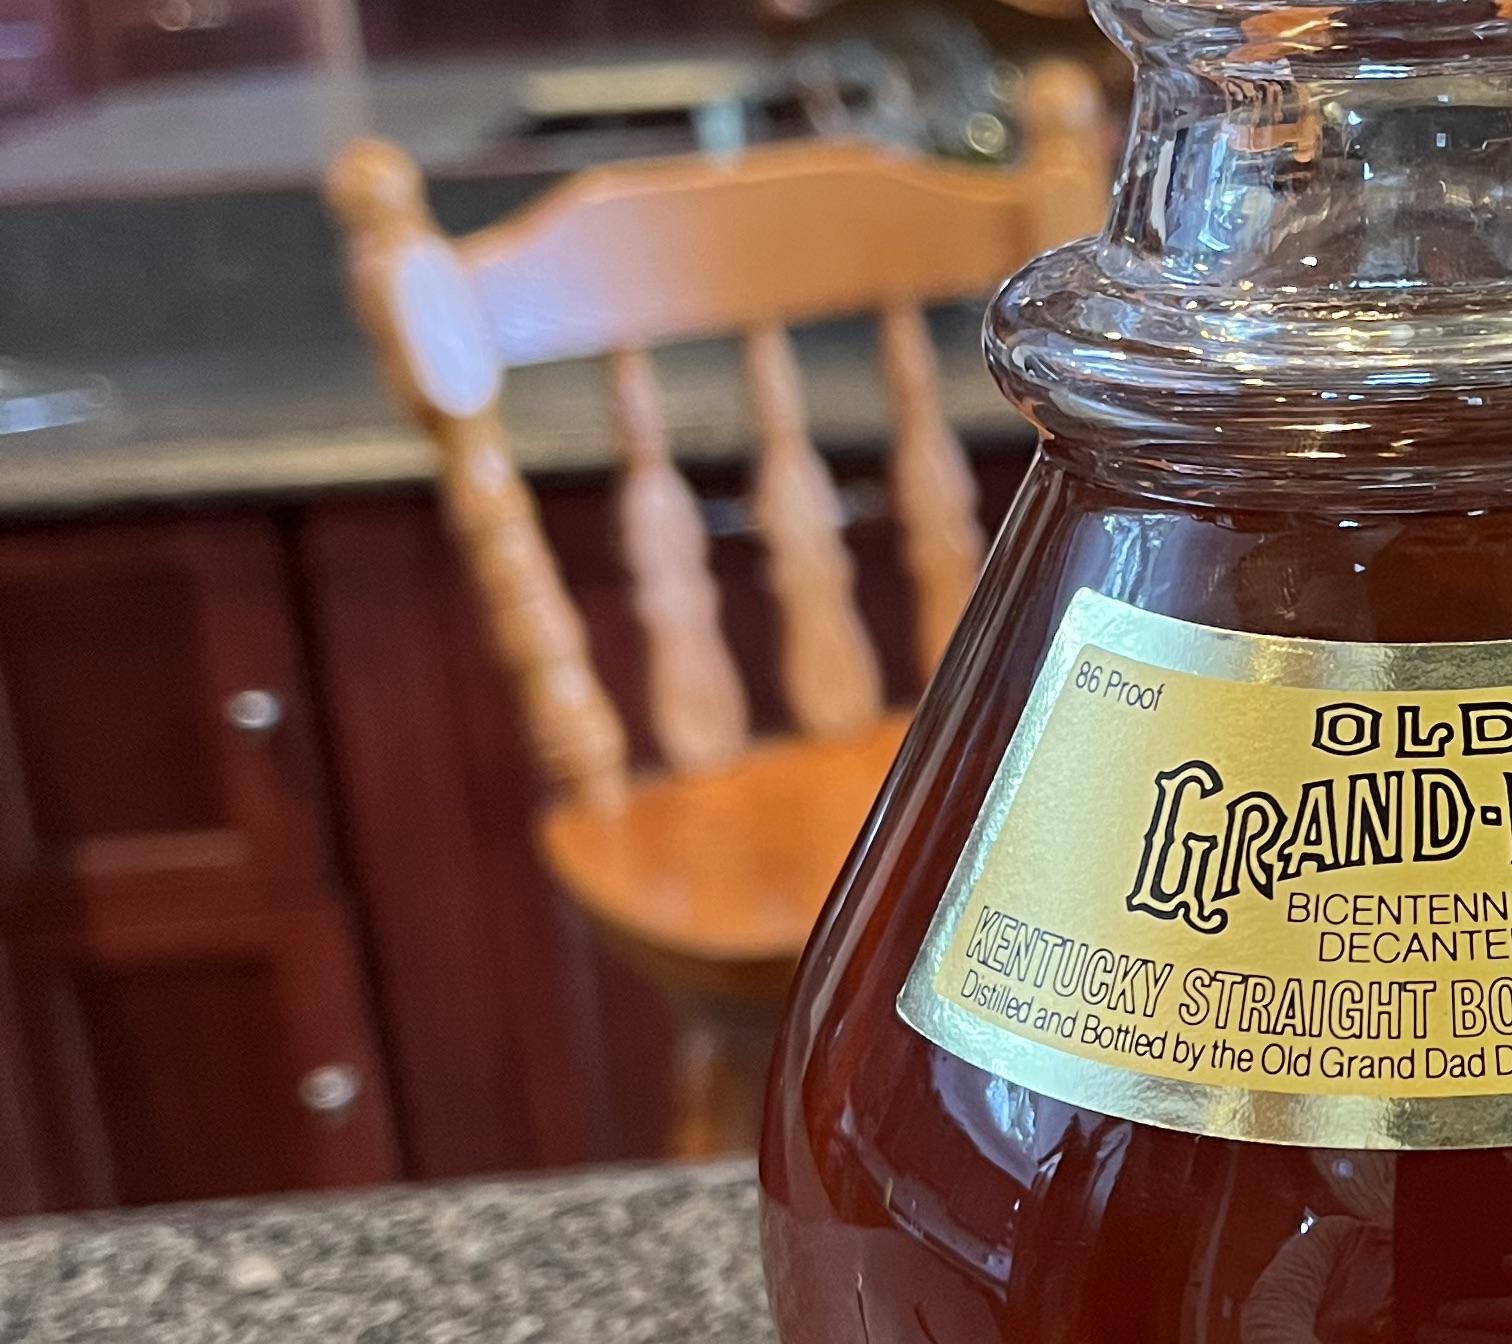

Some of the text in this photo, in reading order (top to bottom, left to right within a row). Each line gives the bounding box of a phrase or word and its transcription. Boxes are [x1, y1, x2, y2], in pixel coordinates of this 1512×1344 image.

[1075, 661, 1166, 712] 86 Proof
[961, 970, 1032, 1027] Distilled
[1034, 1006, 1076, 1039] and
[1081, 1014, 1166, 1061] Bottled
[1172, 1037, 1206, 1073] by
[1210, 1039, 1254, 1074] the
[1260, 1042, 1310, 1078] Old
[1320, 1050, 1415, 1080] Grand
[1426, 1044, 1486, 1080] Dad
[967, 905, 1174, 1018] KENTUCKY
[1179, 968, 1438, 1040] STRAIGHT
